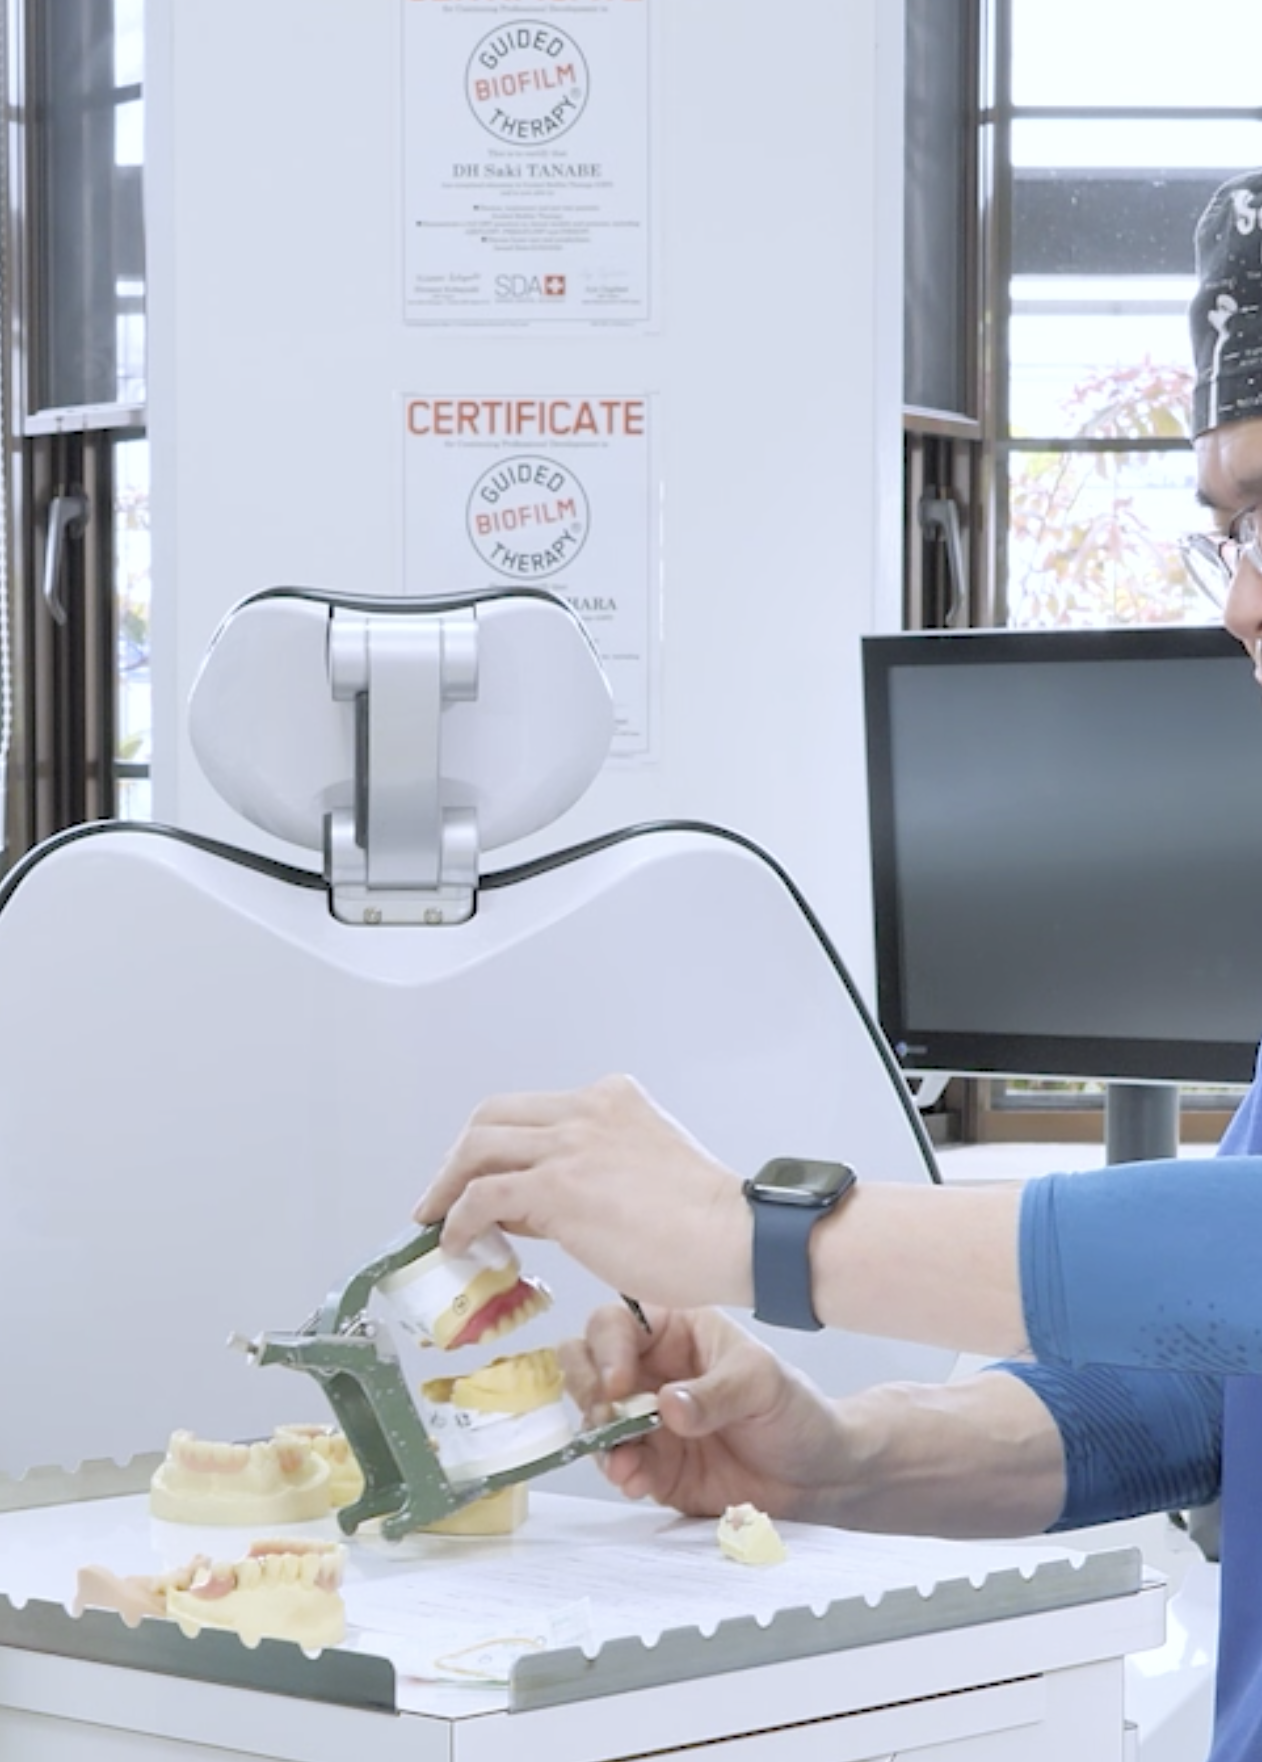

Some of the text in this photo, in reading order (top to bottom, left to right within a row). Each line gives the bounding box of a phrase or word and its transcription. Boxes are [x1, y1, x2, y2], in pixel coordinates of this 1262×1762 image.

[479, 28, 564, 70] GUIDED
[474, 63, 577, 102] BIOFILM
[489, 96, 577, 138] THERAPY
[483, 163, 521, 178] Saki
[526, 163, 602, 178] TANABE
[494, 274, 543, 297] SDA
[406, 400, 645, 436] CERTIFICATE
[480, 463, 565, 505] GUIDED
[475, 498, 577, 536] BIOFILM
[491, 529, 578, 572] THERAPY
